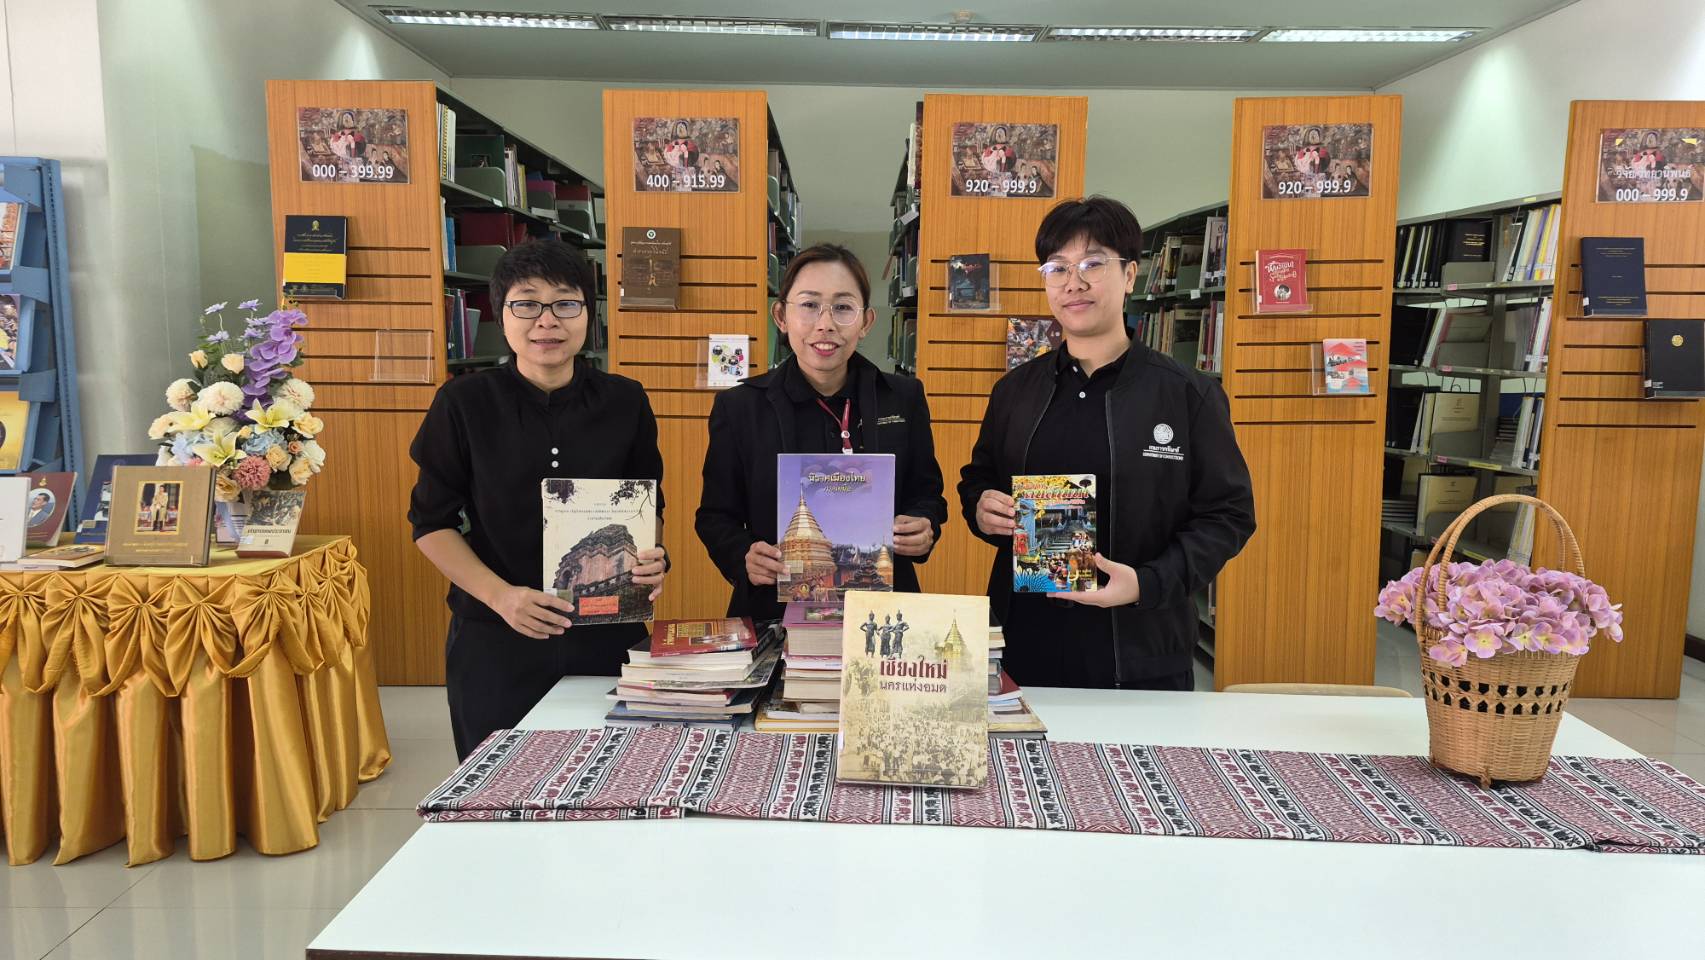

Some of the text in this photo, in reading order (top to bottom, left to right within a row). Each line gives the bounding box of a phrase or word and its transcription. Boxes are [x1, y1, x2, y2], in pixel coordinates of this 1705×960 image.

[312, 164, 336, 178] 000
[351, 164, 394, 179] 399.99
[646, 174, 669, 188] 400
[683, 174, 725, 188] 915.99
[965, 179, 989, 193] 920
[1002, 180, 1037, 193] 999.9
[1278, 181, 1302, 195] 920
[1316, 179, 1352, 193] 999.9
[1616, 188, 1640, 201] 000
[1653, 188, 1689, 201] 999.9
[880, 654, 948, 679] เชียงใหม่
